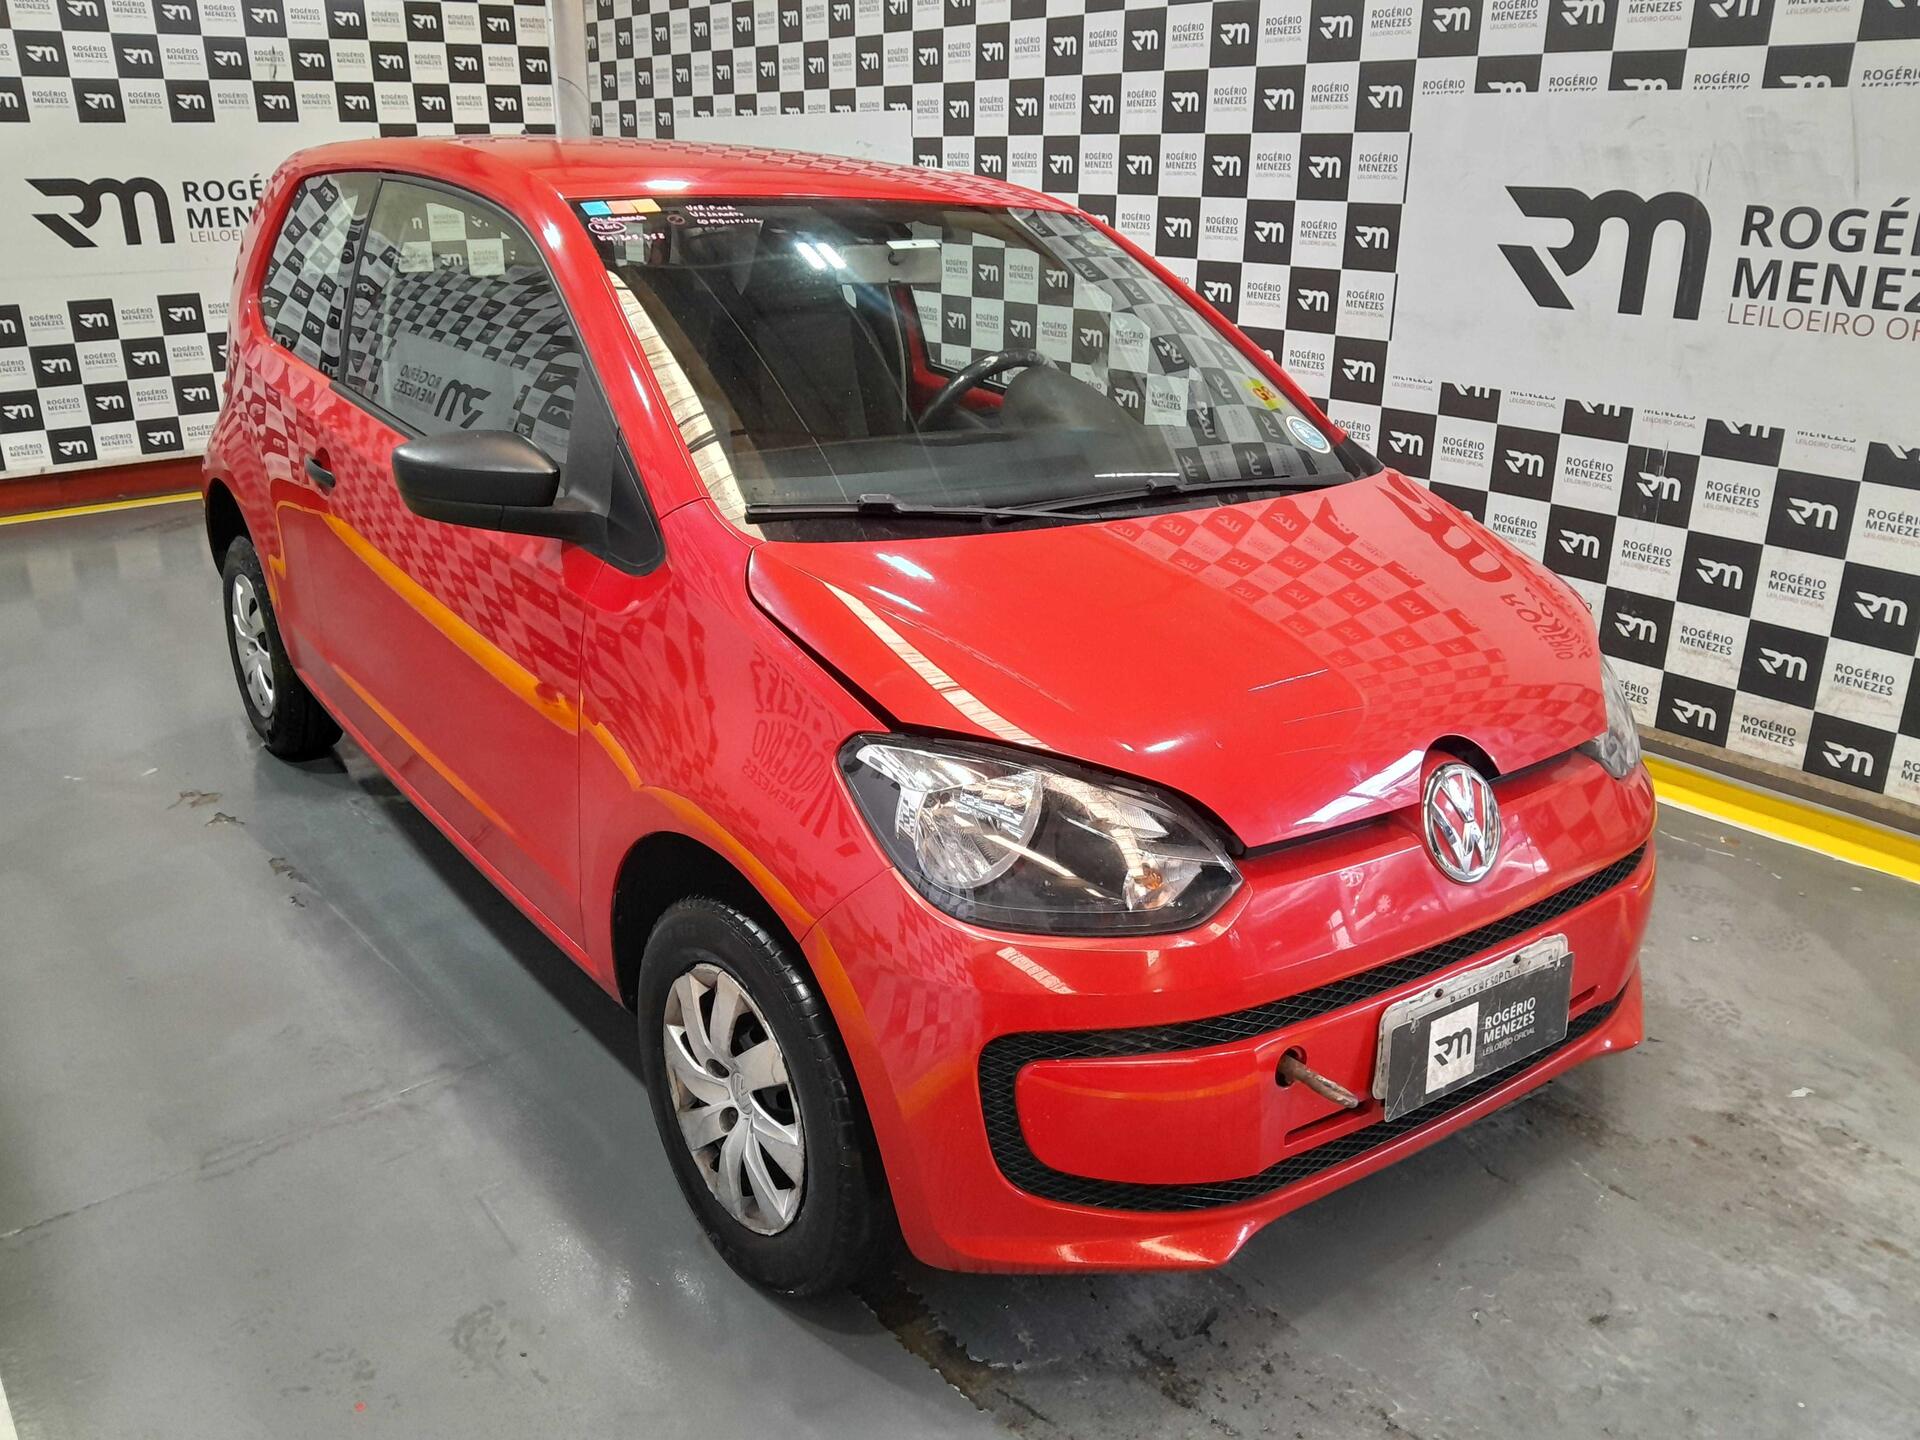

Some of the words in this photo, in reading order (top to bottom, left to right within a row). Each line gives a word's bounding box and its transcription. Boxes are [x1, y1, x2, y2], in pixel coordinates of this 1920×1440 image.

[1372, 4, 1414, 18] ROGÉRIO
[1628, 1, 1683, 14] MENEZES
[1265, 13, 1302, 26] ROGÉRIO
[1371, 16, 1414, 28] MENEZES
[1490, 9, 1538, 22] MENEZES
[1172, 22, 1204, 33] ROGÉRIO
[1265, 24, 1302, 36] MENEZES
[1171, 32, 1204, 43] MENEZES
[1422, 78, 1466, 90] ROGÉRIO
[1549, 73, 1598, 87] ROGÉRIO
[1694, 70, 1751, 84] ROGÉRIO
[1126, 89, 1157, 99] ROGÉRIO
[1213, 85, 1247, 96] ROGÉRIO
[1311, 81, 1350, 93] ROGÉRIO
[1126, 99, 1157, 108] MENEZES
[1213, 96, 1247, 105] MENEZES
[1310, 92, 1349, 102] MENEZES
[1165, 151, 1197, 161] ROGÉRIO
[1256, 151, 1291, 161] ROGÉRIO
[1358, 151, 1399, 162] ROGÉRIO
[1165, 161, 1197, 170] MENEZES
[1255, 162, 1291, 171] MENEZES
[1358, 163, 1399, 172] MENEZES
[182, 173, 263, 202] ROGÉ
[1205, 215, 1238, 225] ROGÉRIO
[1300, 219, 1337, 230] ROGÉRIO
[1740, 197, 1920, 256] ROGÉ
[190, 229, 244, 243] LEILOEI
[1205, 224, 1238, 234] MENEZES
[1299, 229, 1337, 239] MENEZES
[1247, 281, 1281, 292] ROGÉRIO
[1732, 258, 1920, 313] MENEZ
[1246, 290, 1281, 301] MENEZES
[1346, 289, 1385, 301] ROGÉRIO
[1345, 299, 1384, 311] MENEZES
[1728, 303, 1875, 337] LEILOEIRO
[1289, 348, 1326, 361] ROGÉRIO
[1289, 357, 1325, 370] MENEZES
[1334, 418, 1372, 432] ROGÉRIO
[1442, 435, 1485, 451] ROGÉRIO
[1441, 445, 1485, 460] MENEZES
[1565, 456, 1614, 473] ROGÉRIO
[1564, 466, 1613, 483] MENEZES
[1705, 479, 1761, 498] ROGÉRIO
[1704, 490, 1760, 509] MENEZES
[1493, 513, 1538, 530] ROGÉRIO
[1867, 508, 1920, 526] ROGÉRI
[1492, 522, 1537, 539] MENEZES
[1865, 519, 1920, 538] MENEZE
[1622, 539, 1673, 558] ROGÉRIO
[1620, 549, 1672, 568] MENEZES
[1768, 569, 1827, 590] ROGÉRIO
[1767, 579, 1826, 600] MENEZES
[1680, 625, 1734, 646] ROGÉRIO
[1679, 634, 1733, 656] MENEZES
[1834, 661, 1896, 685] ROGÉRIO
[1832, 672, 1895, 696] MENEZES
[1741, 713, 1797, 737] ROGÉRIO
[1739, 723, 1796, 747] MENEZES
[1485, 997, 1536, 1029] ROGÉRIO
[1483, 1011, 1535, 1044] MENEZES
